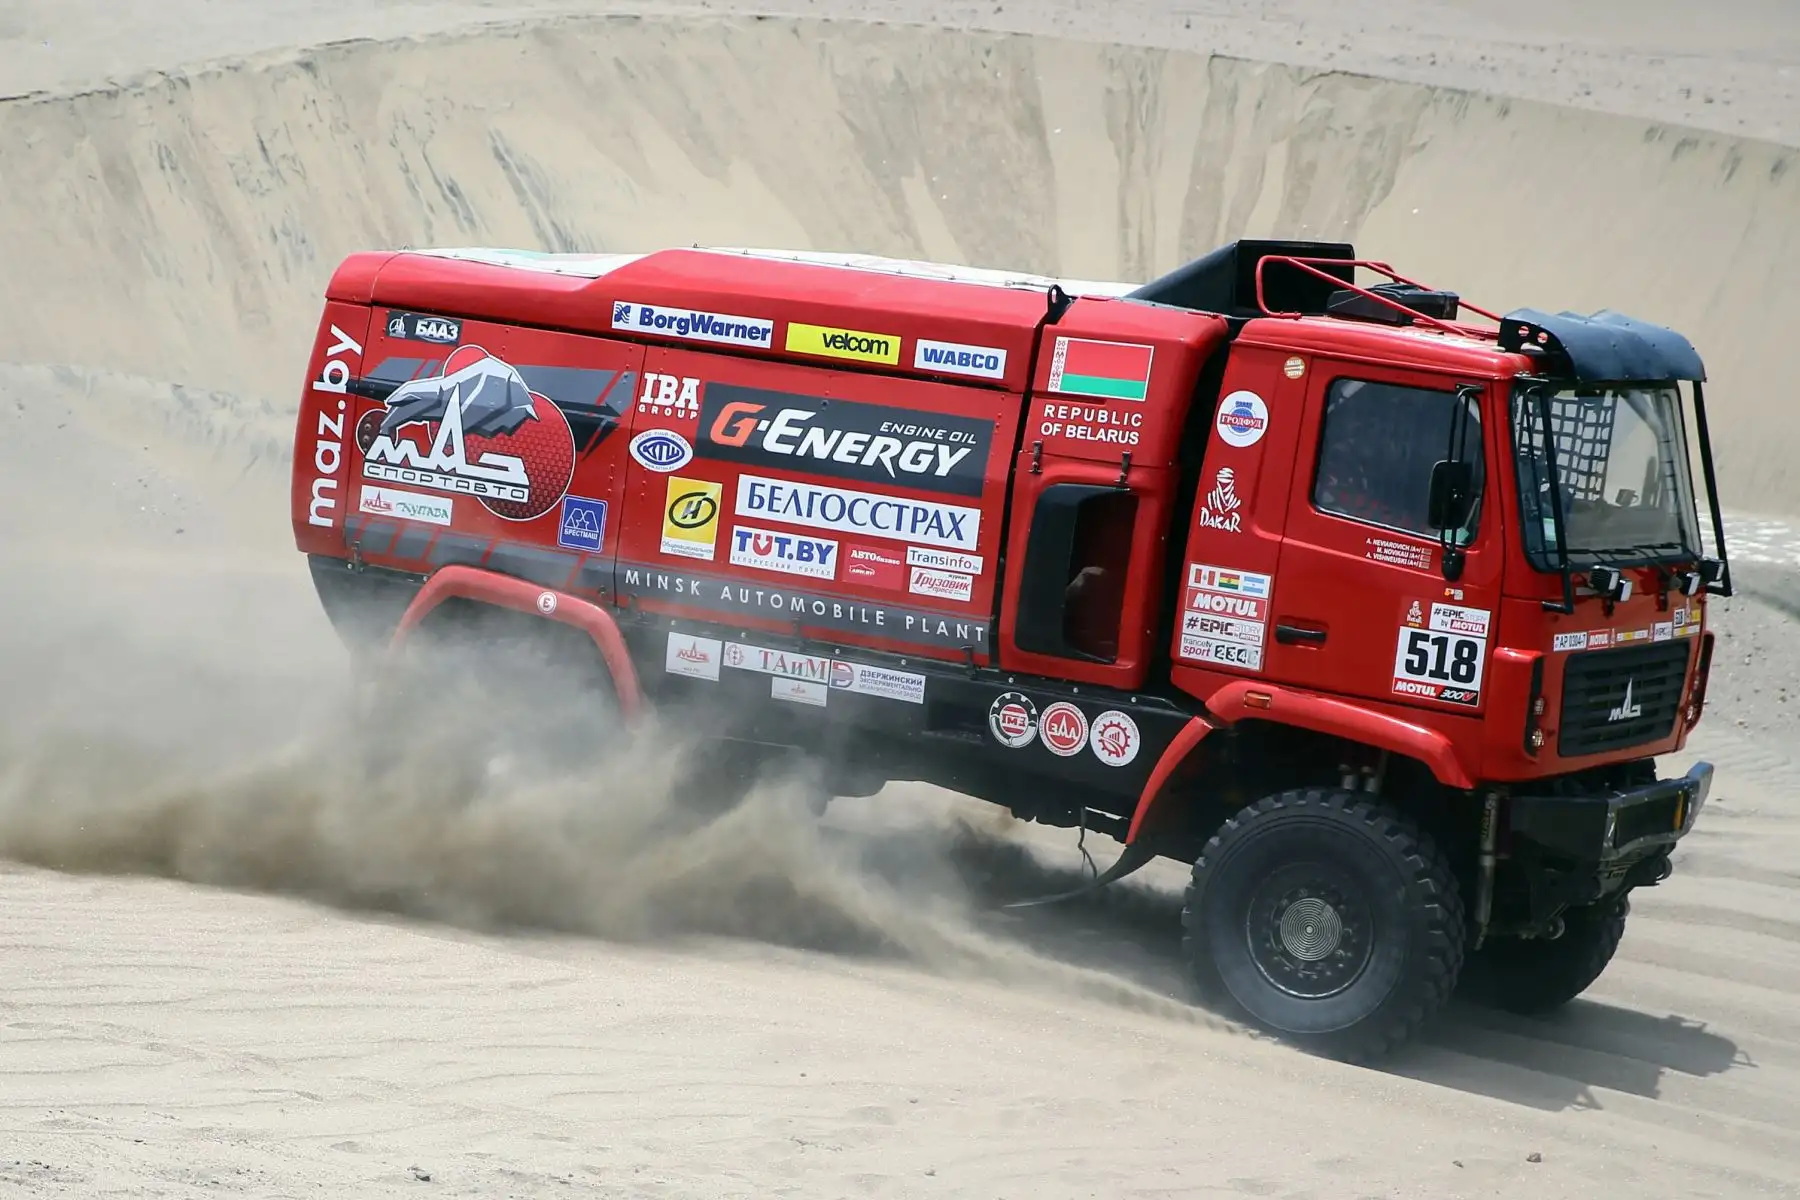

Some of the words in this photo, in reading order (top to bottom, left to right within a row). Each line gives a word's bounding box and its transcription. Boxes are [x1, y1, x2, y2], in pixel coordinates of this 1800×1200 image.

[415, 319, 459, 340] БААЗ
[638, 307, 771, 343] BorgWarner
[822, 331, 890, 357] velcom
[922, 347, 1000, 371] WABCO
[640, 371, 699, 413] IBA
[638, 404, 699, 421] GROUP
[1044, 404, 1142, 427] REPUBLIC
[1221, 414, 1262, 429] ГРОДФУД
[308, 323, 363, 528] maz.by
[879, 421, 947, 441] ENGINE
[948, 430, 977, 444] OIL
[1041, 422, 1063, 436] OF
[1065, 424, 1140, 445] BELARUS
[367, 465, 525, 500] СПОРТАВТО
[747, 482, 967, 541] БЕЛГОССТРАХ
[1200, 507, 1241, 532] DAKAR
[564, 528, 598, 540] БРЕСТМАШ
[736, 530, 834, 565] TUT.BY
[625, 569, 700, 596] MINSK
[720, 585, 885, 626] AUTOMOBILE
[905, 604, 984, 642] PLANT
[1192, 593, 1258, 618] MOTUL
[1450, 620, 1485, 633] MOTUL
[1183, 645, 1211, 657] sport
[1405, 631, 1479, 683] 518
[758, 649, 827, 680] ТАиМ
[860, 669, 923, 686] ДЗЕРЖИНСКИЙ
[1395, 681, 1437, 697] MOTUL
[1439, 689, 1476, 702] 300V
